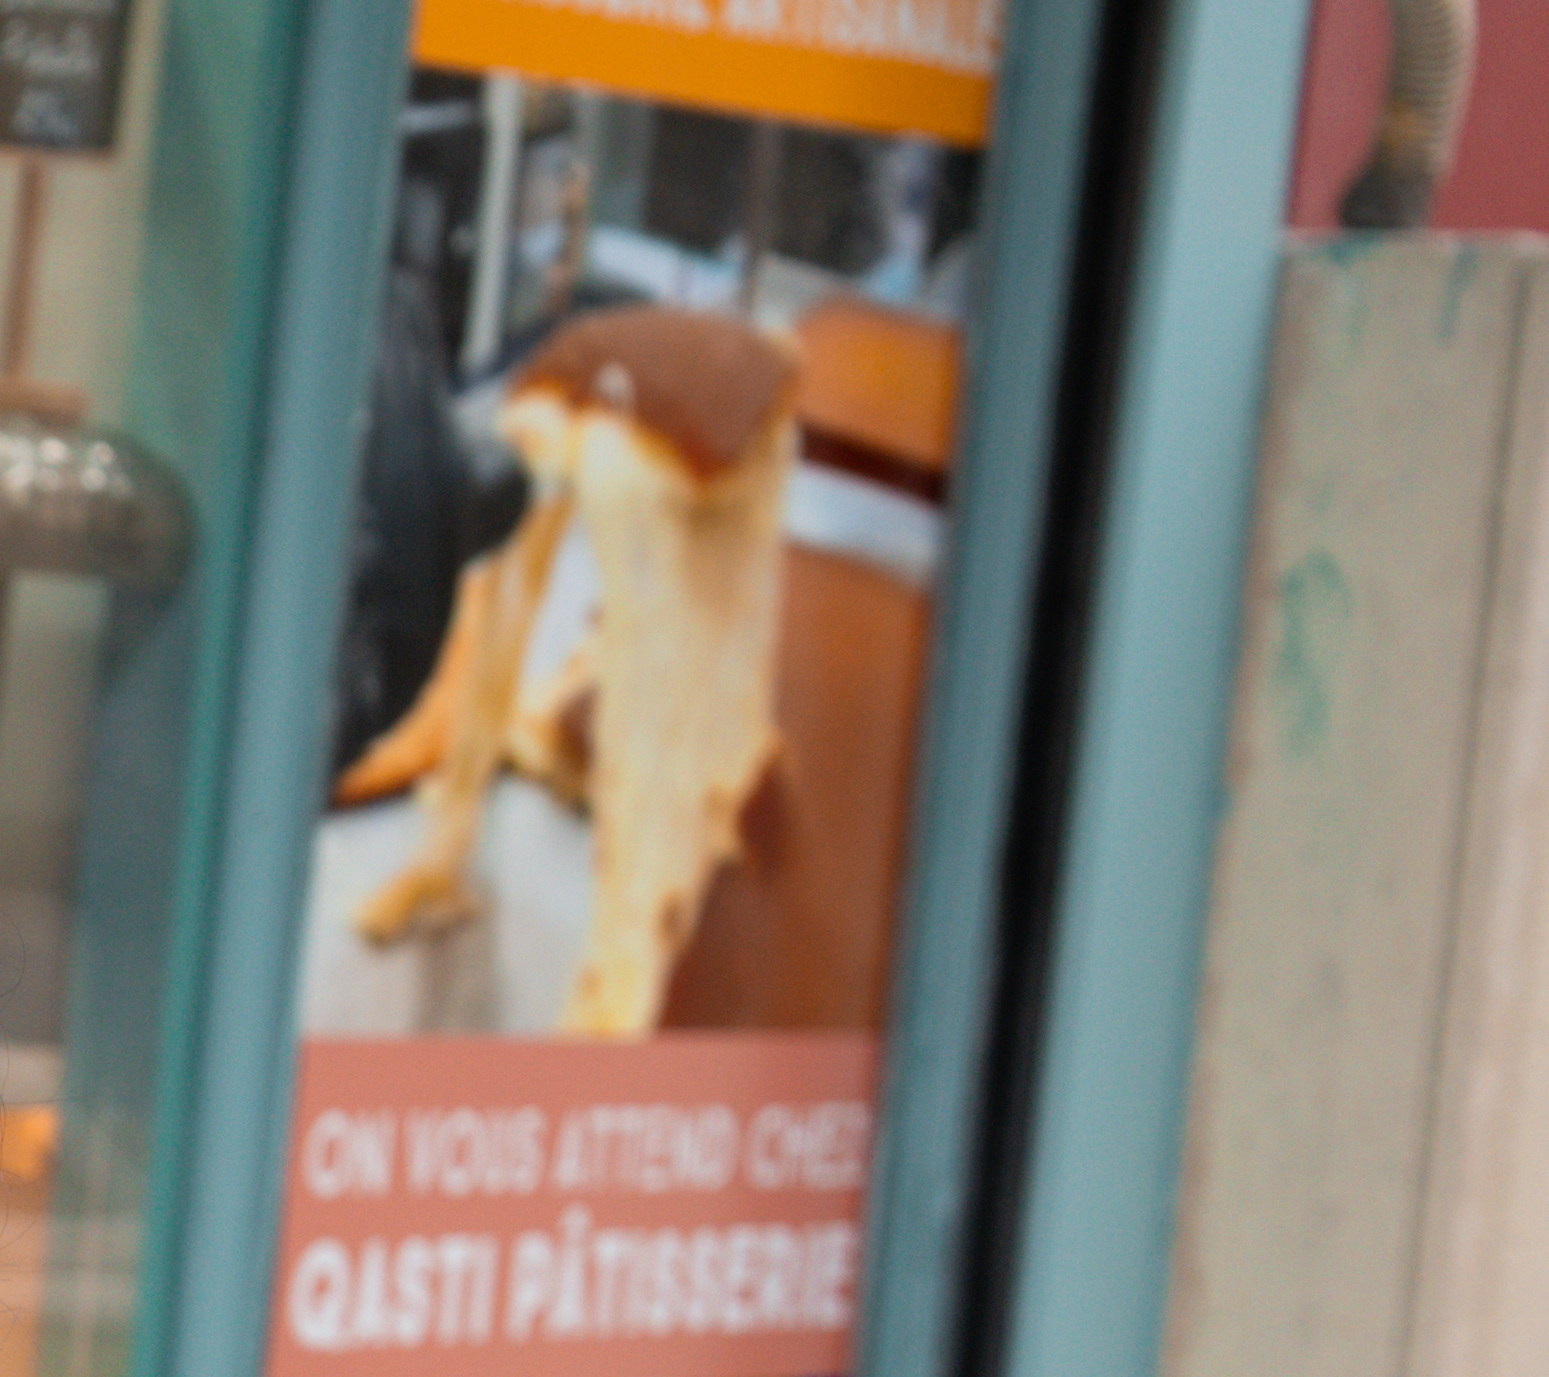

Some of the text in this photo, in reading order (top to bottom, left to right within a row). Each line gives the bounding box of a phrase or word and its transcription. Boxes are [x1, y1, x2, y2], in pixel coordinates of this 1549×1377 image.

[302, 1106, 396, 1198] ON
[404, 1104, 546, 1197] VOUS
[552, 1103, 739, 1193] ATTEND
[287, 1201, 858, 1350] QASTI PÂTISSERIE
